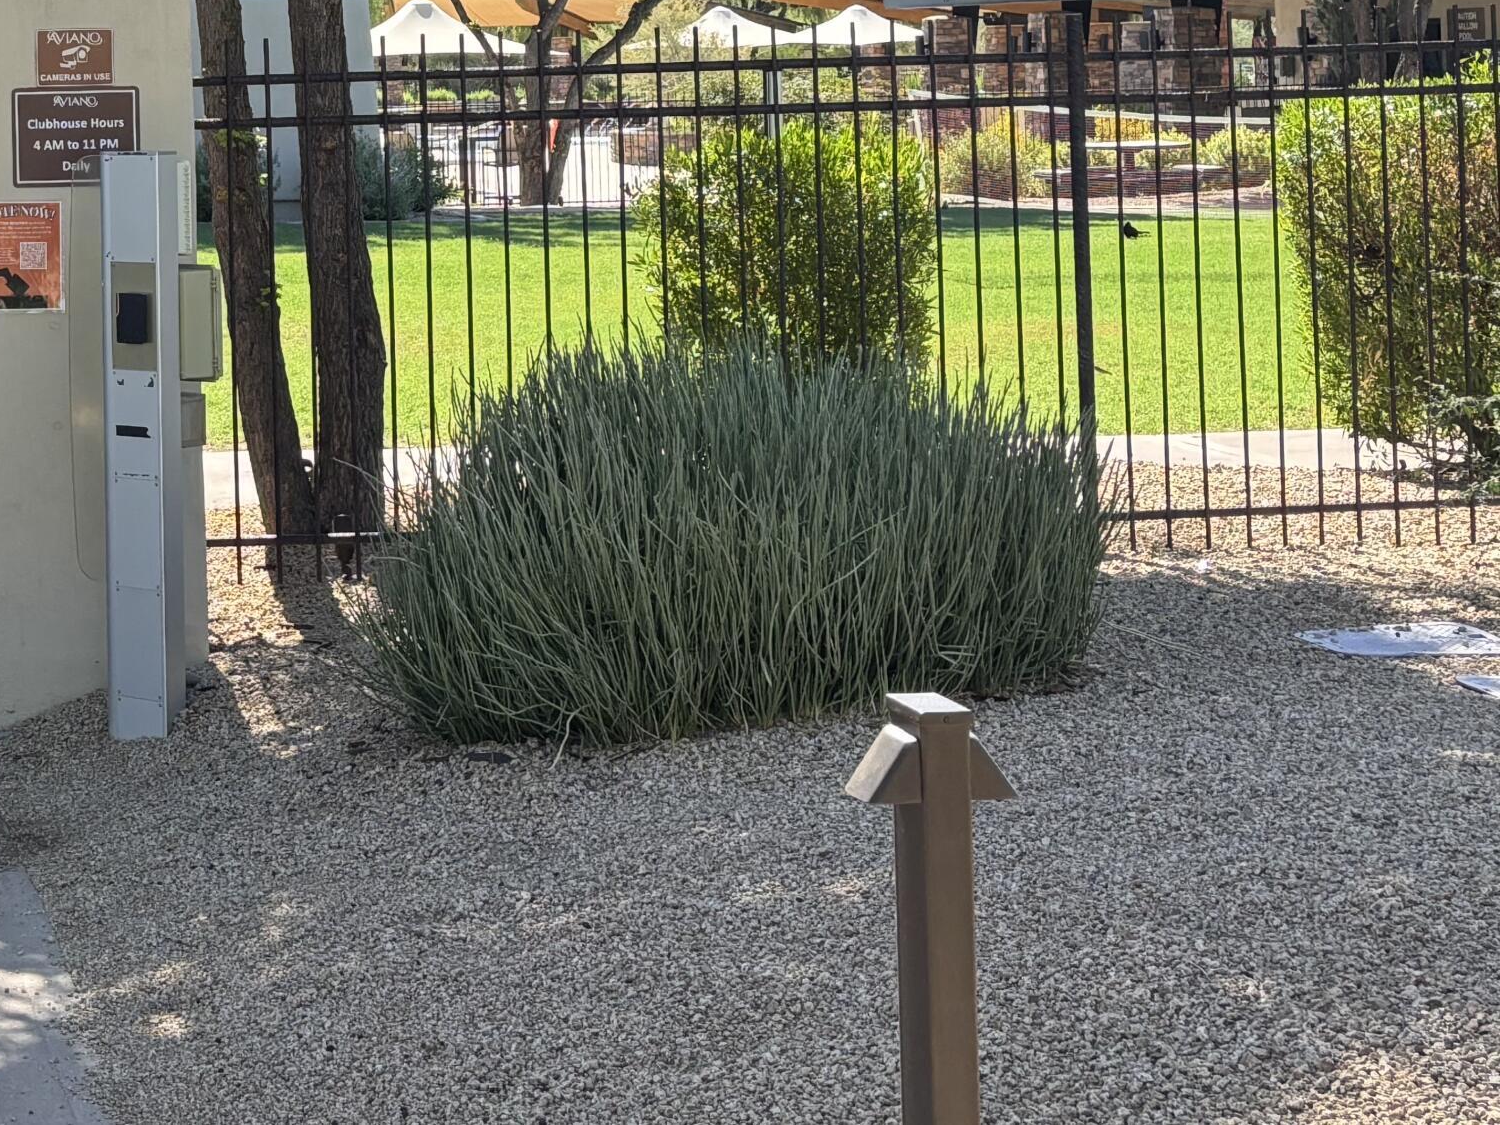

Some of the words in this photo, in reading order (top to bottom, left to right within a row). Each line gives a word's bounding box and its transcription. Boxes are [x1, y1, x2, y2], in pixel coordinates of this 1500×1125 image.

[46, 31, 103, 45] AVIANO
[40, 73, 81, 82] CAMERAS
[83, 73, 92, 81] IN
[94, 72, 111, 81] USE
[53, 95, 99, 107] AVIANO
[27, 118, 88, 129] Clubhouse
[90, 117, 125, 128] Hours
[33, 140, 41, 150] 4
[43, 139, 64, 150] AM
[67, 139, 80, 150] to
[82, 138, 97, 150] 11
[99, 138, 119, 149] PM
[62, 160, 90, 173] Daily
[20, 205, 56, 221] NOW!
